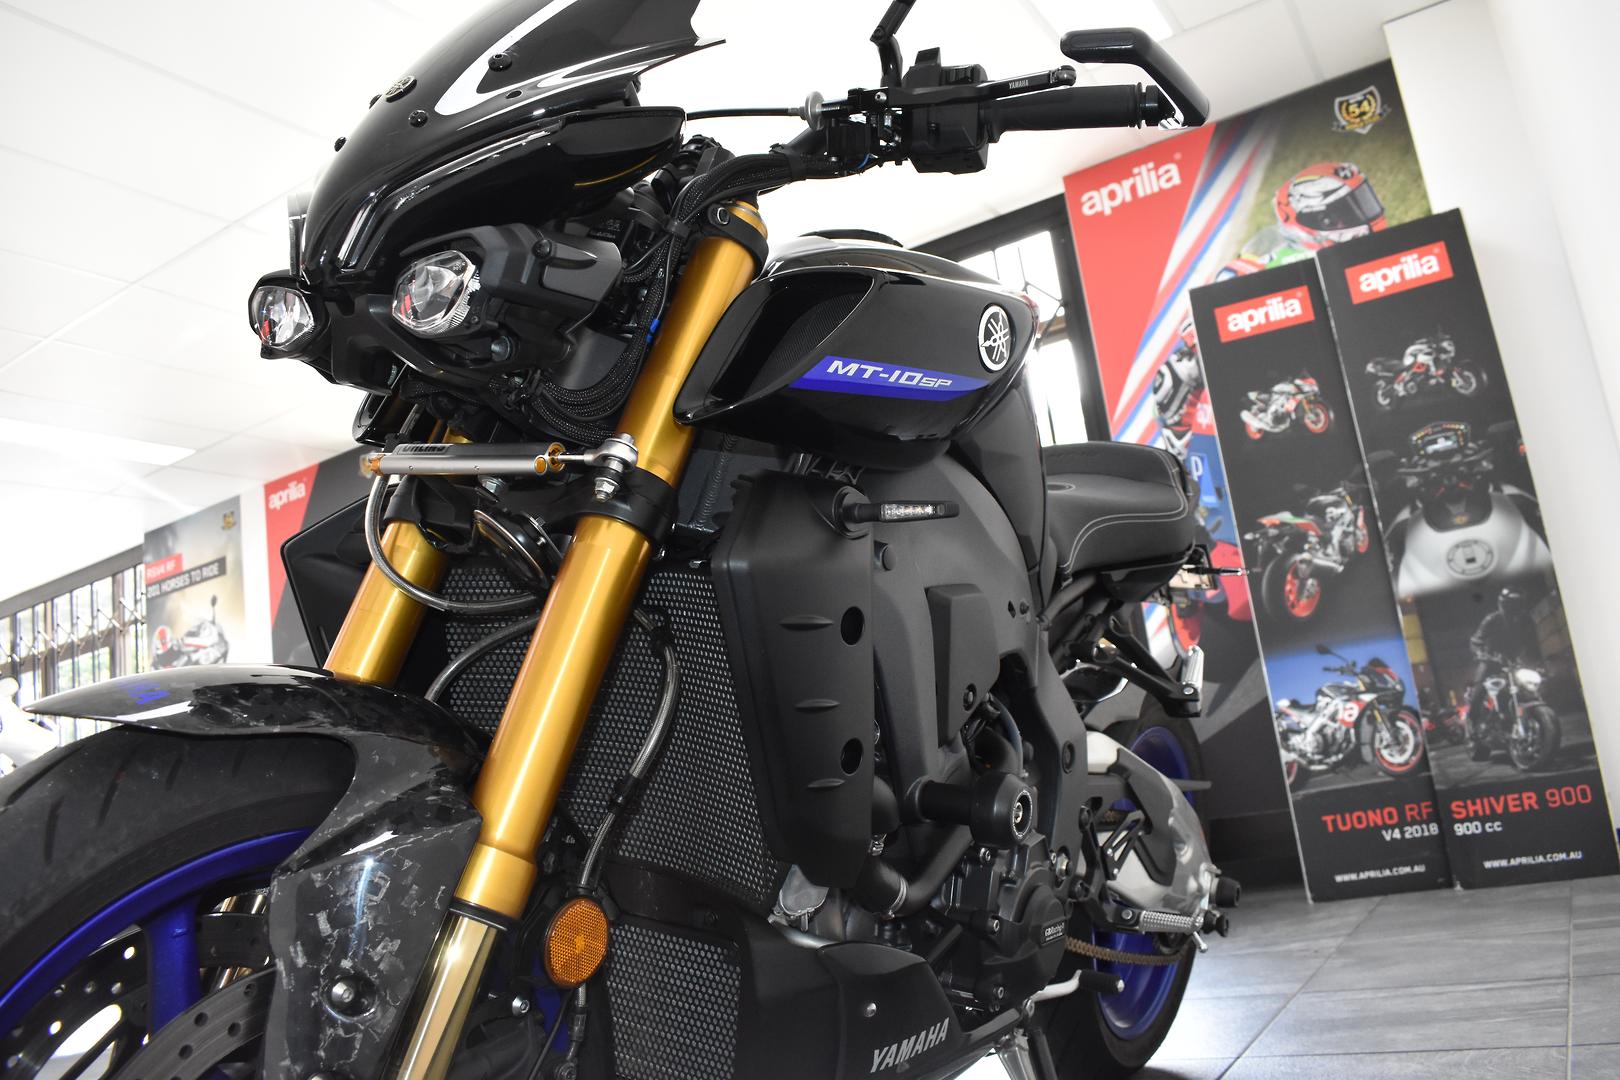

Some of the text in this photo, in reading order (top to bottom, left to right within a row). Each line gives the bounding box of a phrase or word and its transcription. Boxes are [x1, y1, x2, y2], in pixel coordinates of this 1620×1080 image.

[1081, 161, 1182, 216] aprilia
[1358, 253, 1441, 292] aprilia
[1226, 296, 1303, 333] aprilia
[268, 480, 306, 511] aprilia
[161, 572, 190, 593] HORSES
[191, 569, 202, 584] TO
[202, 561, 219, 579] RIDE
[1321, 801, 1434, 833] TUONO RF
[1450, 784, 1593, 820] SHIVER 900
[1381, 822, 1439, 841] V4 2018
[1453, 820, 1503, 836] 900 cc
[1333, 864, 1426, 883] WWW.APRILIA.COM.AU
[1483, 851, 1583, 869] WWW.APRILIA.COM.AU
[870, 1016, 950, 1074] YAMAHA
